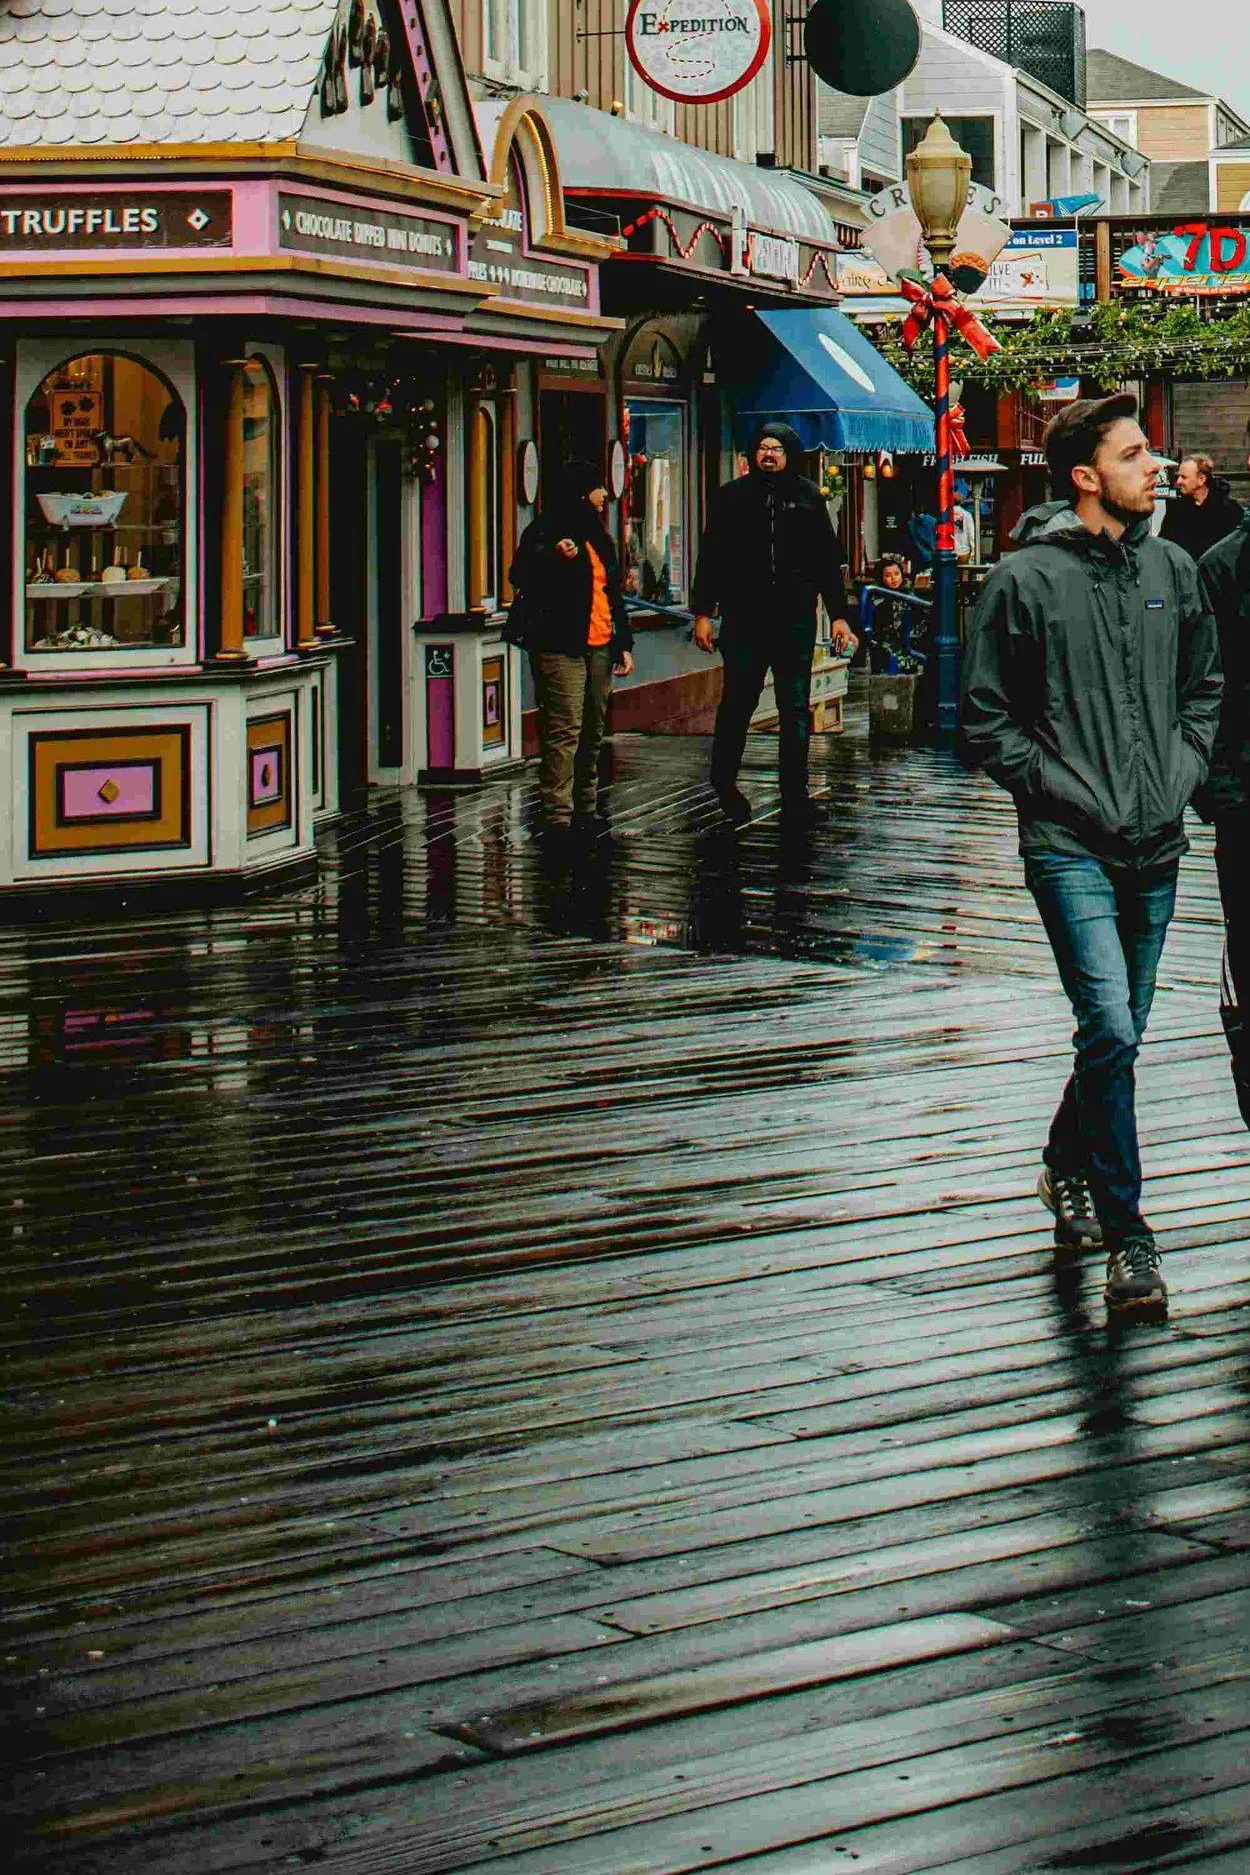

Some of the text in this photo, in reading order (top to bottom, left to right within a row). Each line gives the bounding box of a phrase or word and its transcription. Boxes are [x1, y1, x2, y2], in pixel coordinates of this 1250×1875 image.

[0, 208, 159, 234] TRUFFLES
[296, 212, 353, 242] CHOCOLATE
[1013, 236, 1026, 245] on
[1028, 234, 1055, 245] Level
[1056, 234, 1063, 245] 2
[1174, 223, 1246, 272] 7D
